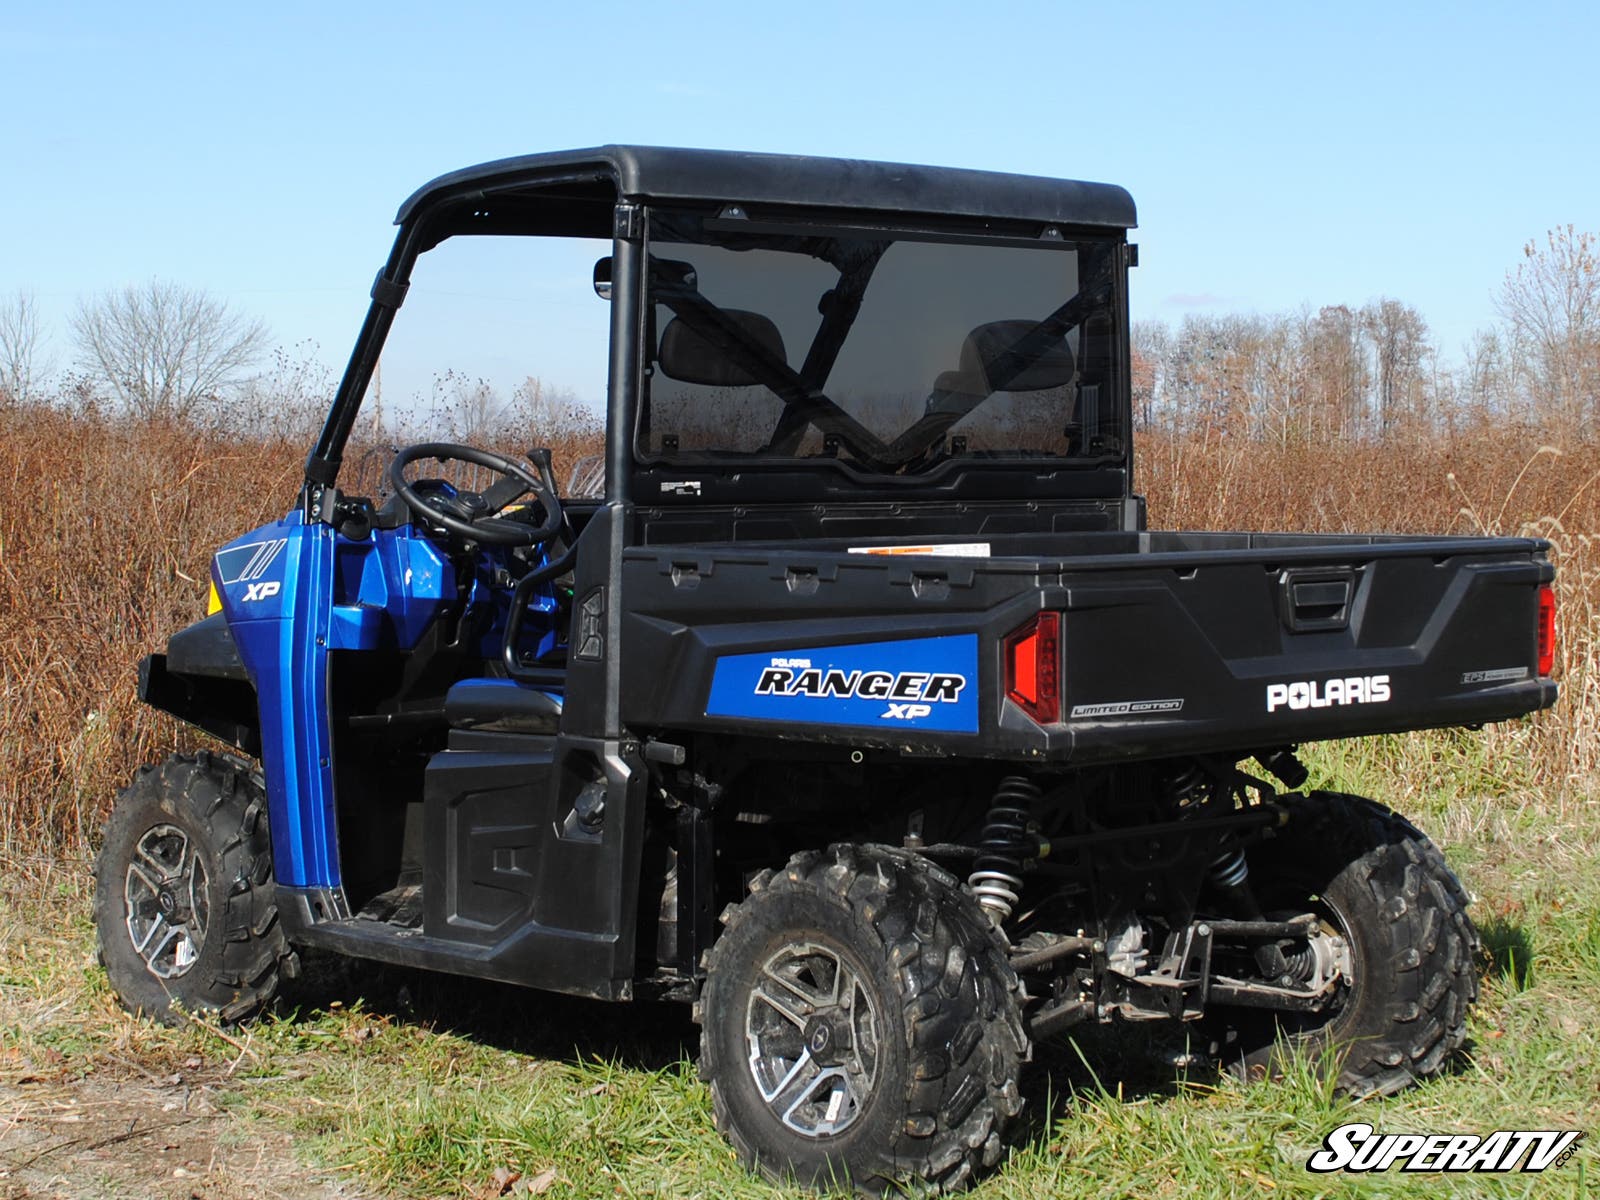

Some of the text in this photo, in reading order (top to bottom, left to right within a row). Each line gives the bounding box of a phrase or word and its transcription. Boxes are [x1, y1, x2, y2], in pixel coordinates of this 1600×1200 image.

[242, 581, 281, 601] XP
[771, 658, 811, 668] POLARIS
[754, 667, 966, 702] RANGER
[1463, 671, 1487, 683] EPS
[1266, 674, 1391, 712] POLARIS
[880, 703, 932, 719] XP
[1073, 701, 1181, 717] LIMITED EDITION
